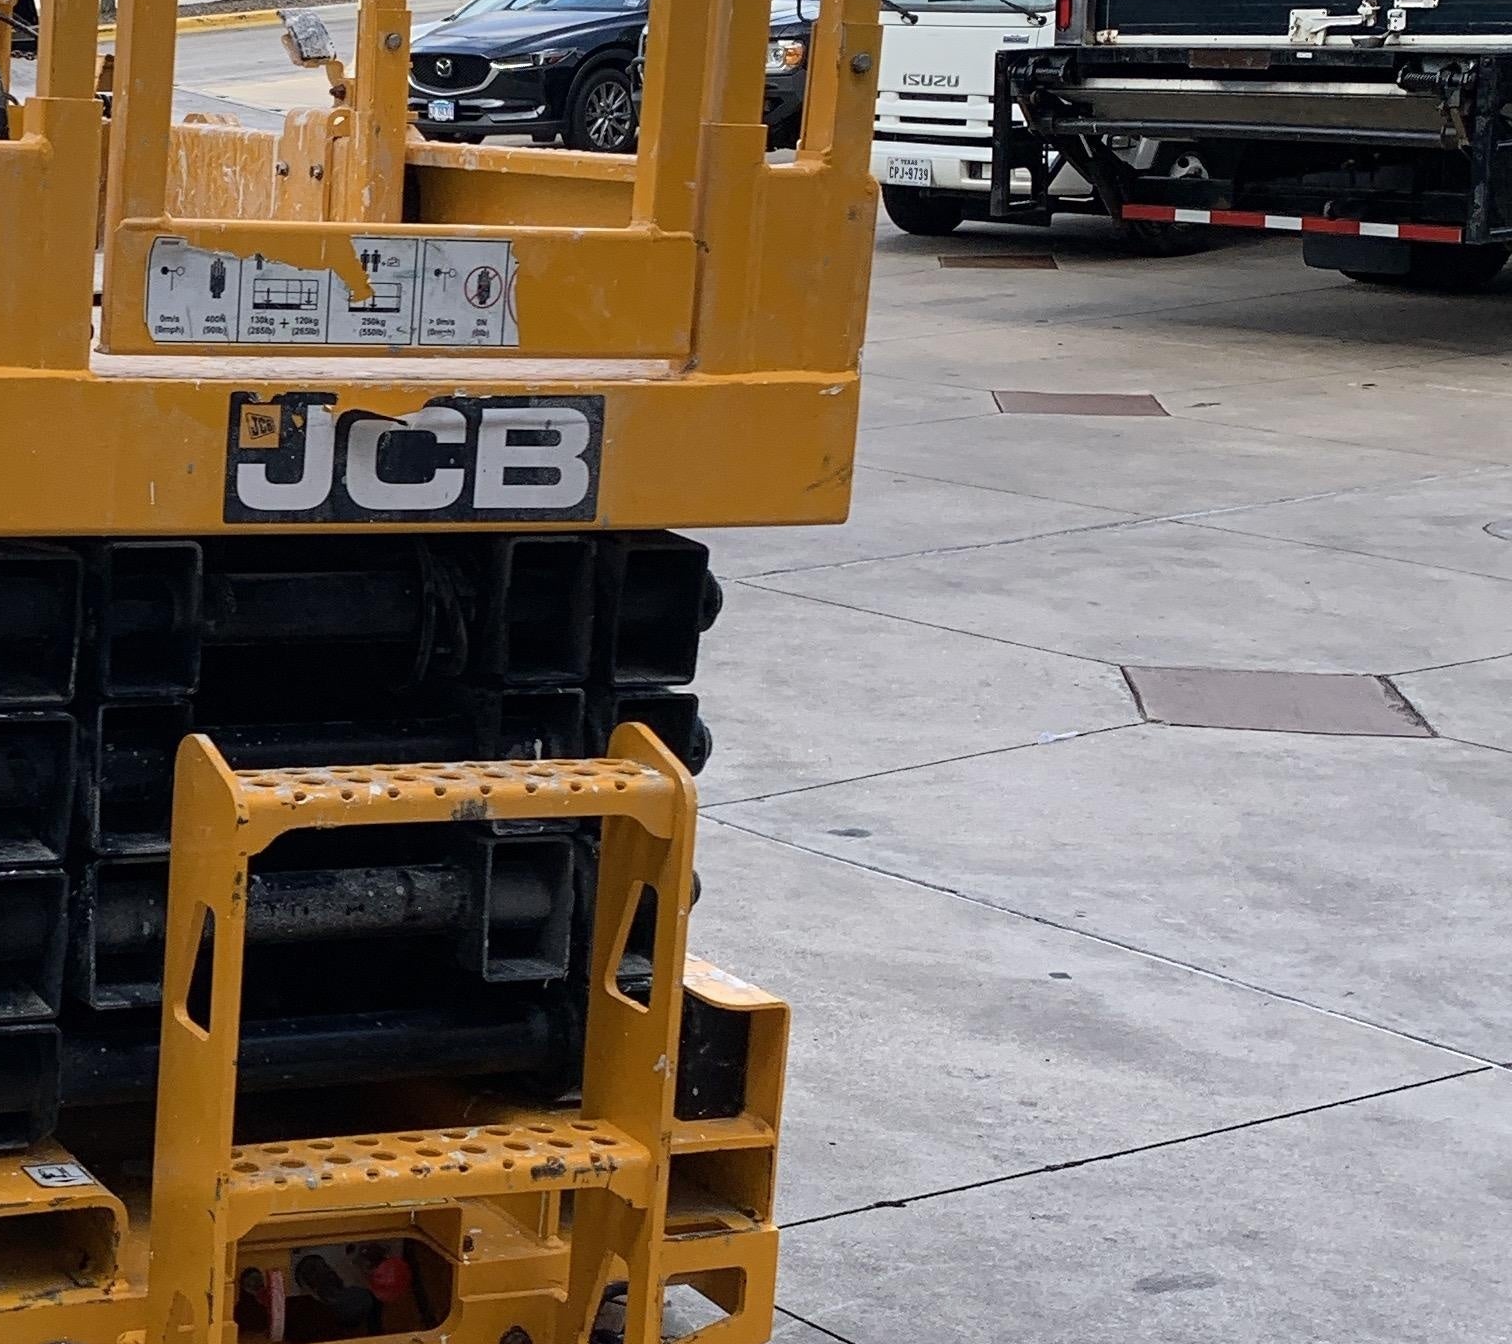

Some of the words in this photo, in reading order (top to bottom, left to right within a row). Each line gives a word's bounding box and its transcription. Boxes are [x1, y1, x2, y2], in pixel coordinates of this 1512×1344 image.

[902, 73, 960, 88] ISUZU
[250, 315, 275, 326] 130kg
[235, 402, 591, 512] JCB
